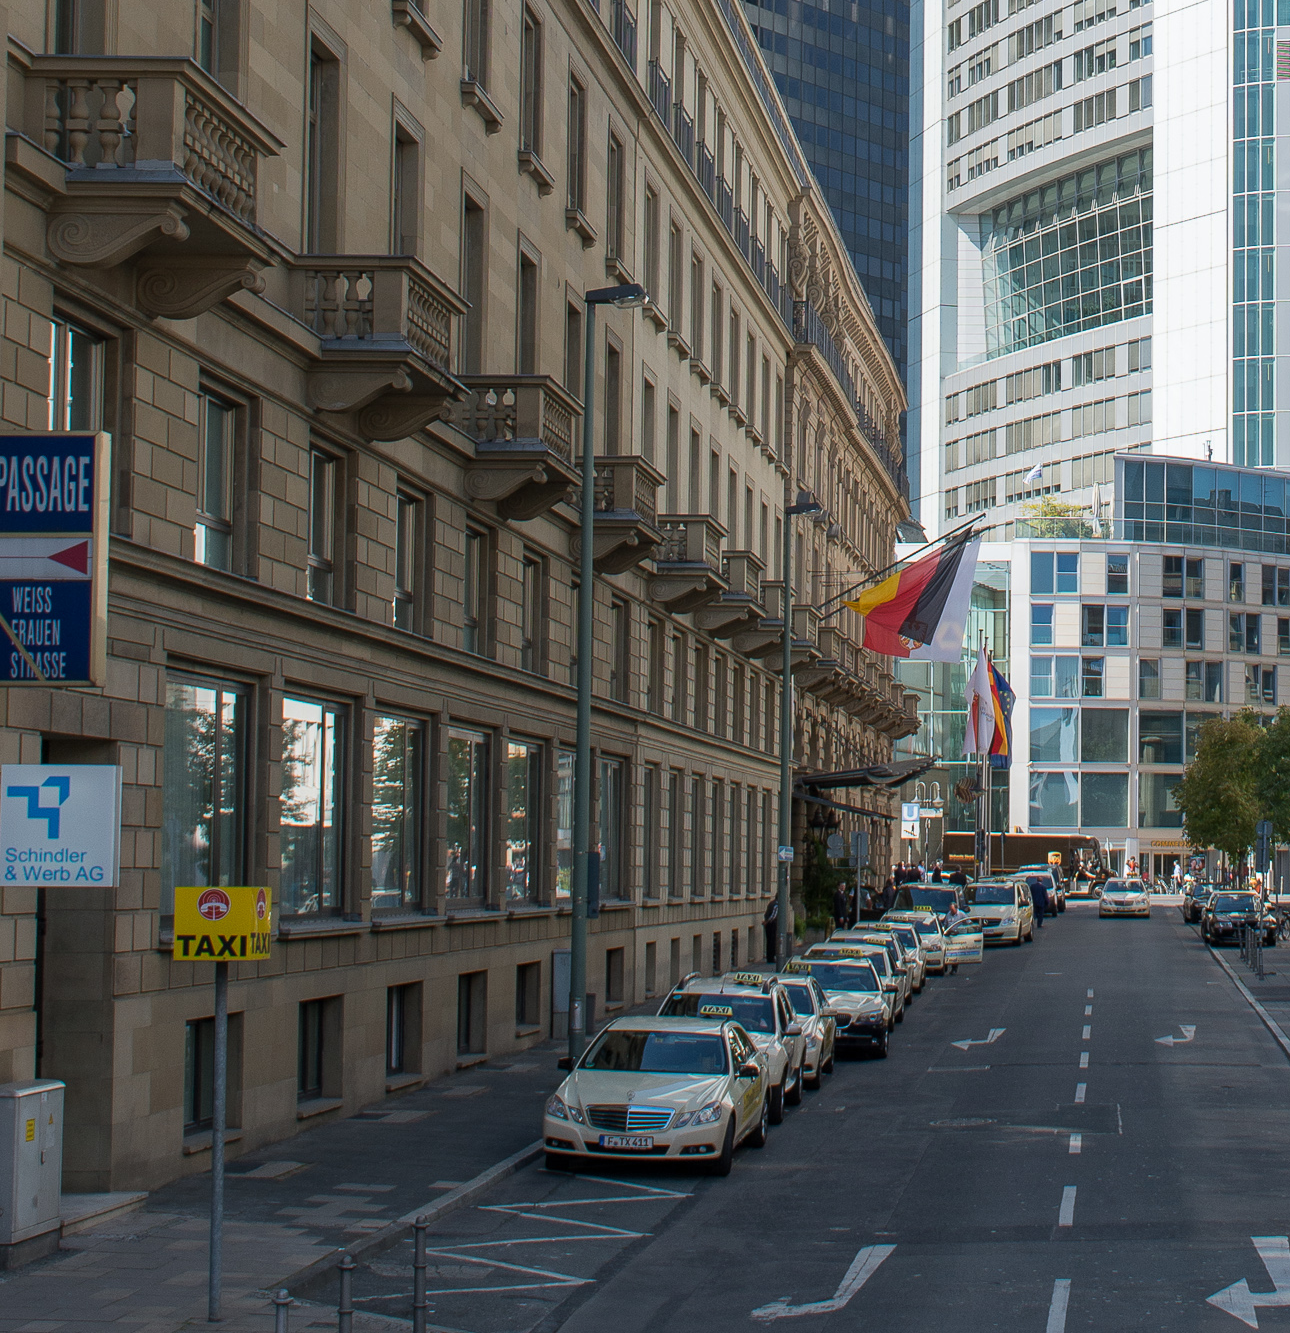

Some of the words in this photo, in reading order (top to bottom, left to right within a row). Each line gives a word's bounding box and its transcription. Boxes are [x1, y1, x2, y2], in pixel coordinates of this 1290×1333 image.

[12, 586, 52, 613] WEISS
[11, 619, 61, 646] FRAUEN
[904, 806, 918, 819] U
[5, 847, 87, 863] Schindler
[4, 865, 17, 881] &
[23, 865, 70, 881] Werb
[75, 865, 104, 881] AG
[176, 934, 248, 957] TAXI
[251, 932, 271, 954] TAXI
[739, 973, 759, 982] TAXI
[705, 1005, 729, 1014] TAXI
[632, 1137, 649, 1147] 411
